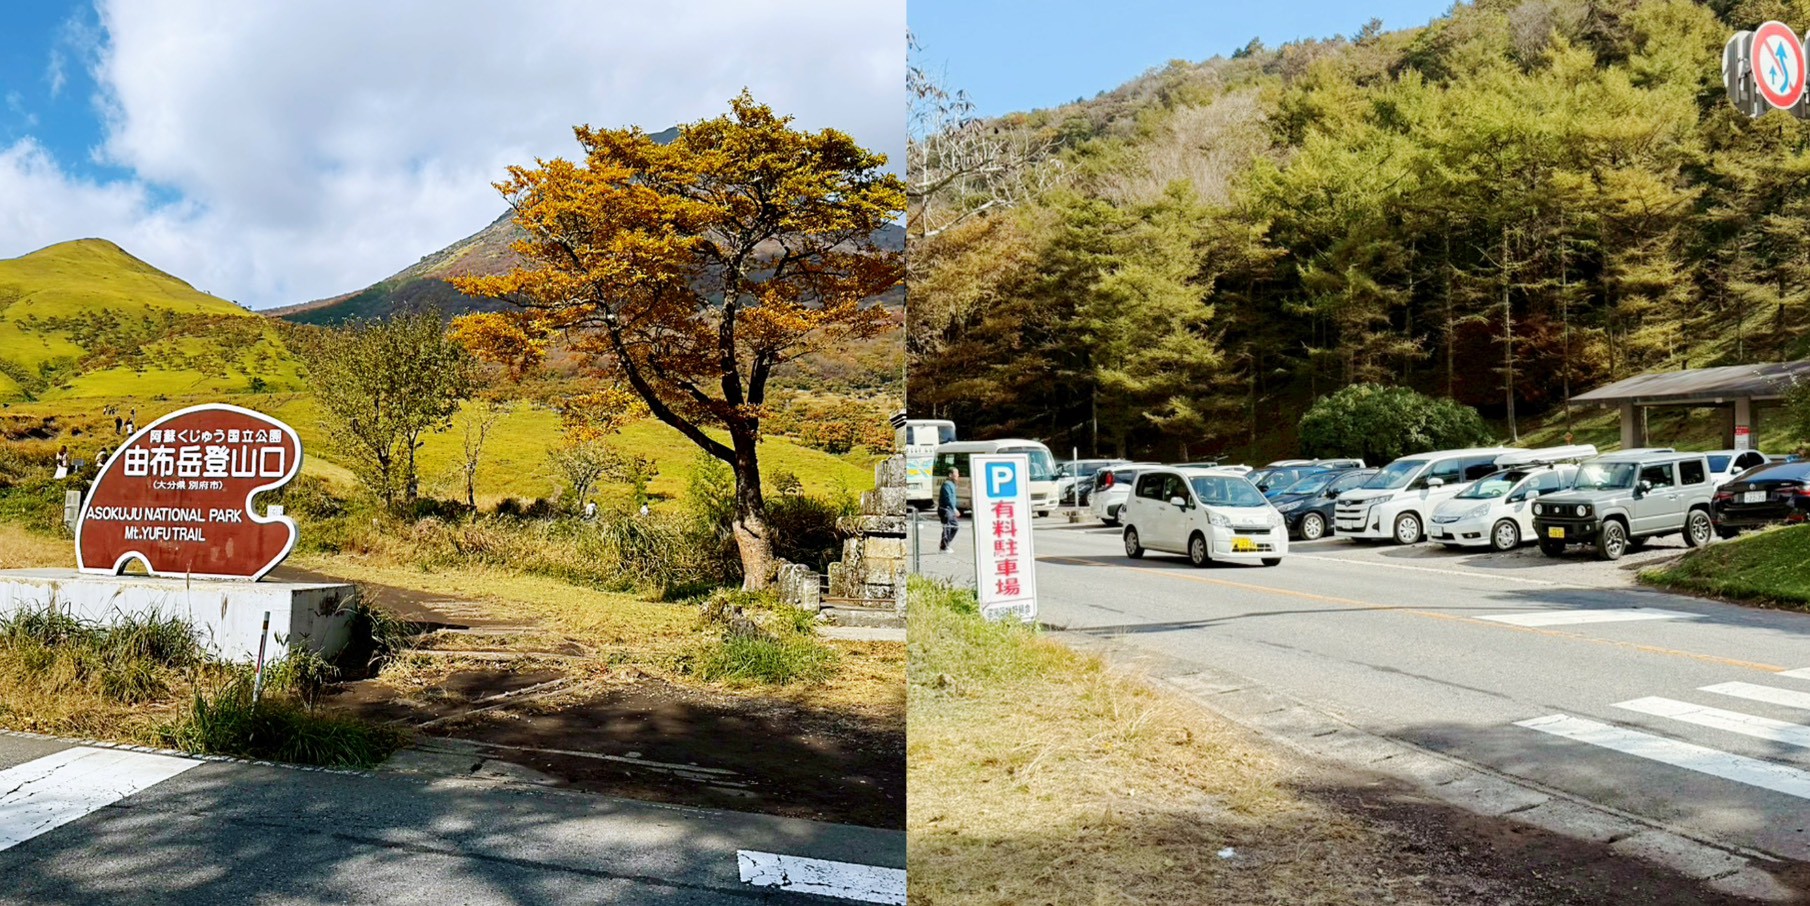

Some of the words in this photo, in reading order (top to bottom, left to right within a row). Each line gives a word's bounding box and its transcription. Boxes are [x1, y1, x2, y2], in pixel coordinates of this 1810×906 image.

[149, 429, 282, 443] 阿蘇くじゅう国立公園
[124, 444, 285, 478] 由布岳登山口
[991, 466, 1014, 495] P
[86, 507, 143, 521] ASOKUJU
[144, 507, 205, 522] NATIONAL
[209, 509, 242, 523] PARK
[124, 526, 170, 540] Mt.YUFU
[172, 527, 206, 541] TRAIL
[991, 499, 1020, 596] 有料駐車場
